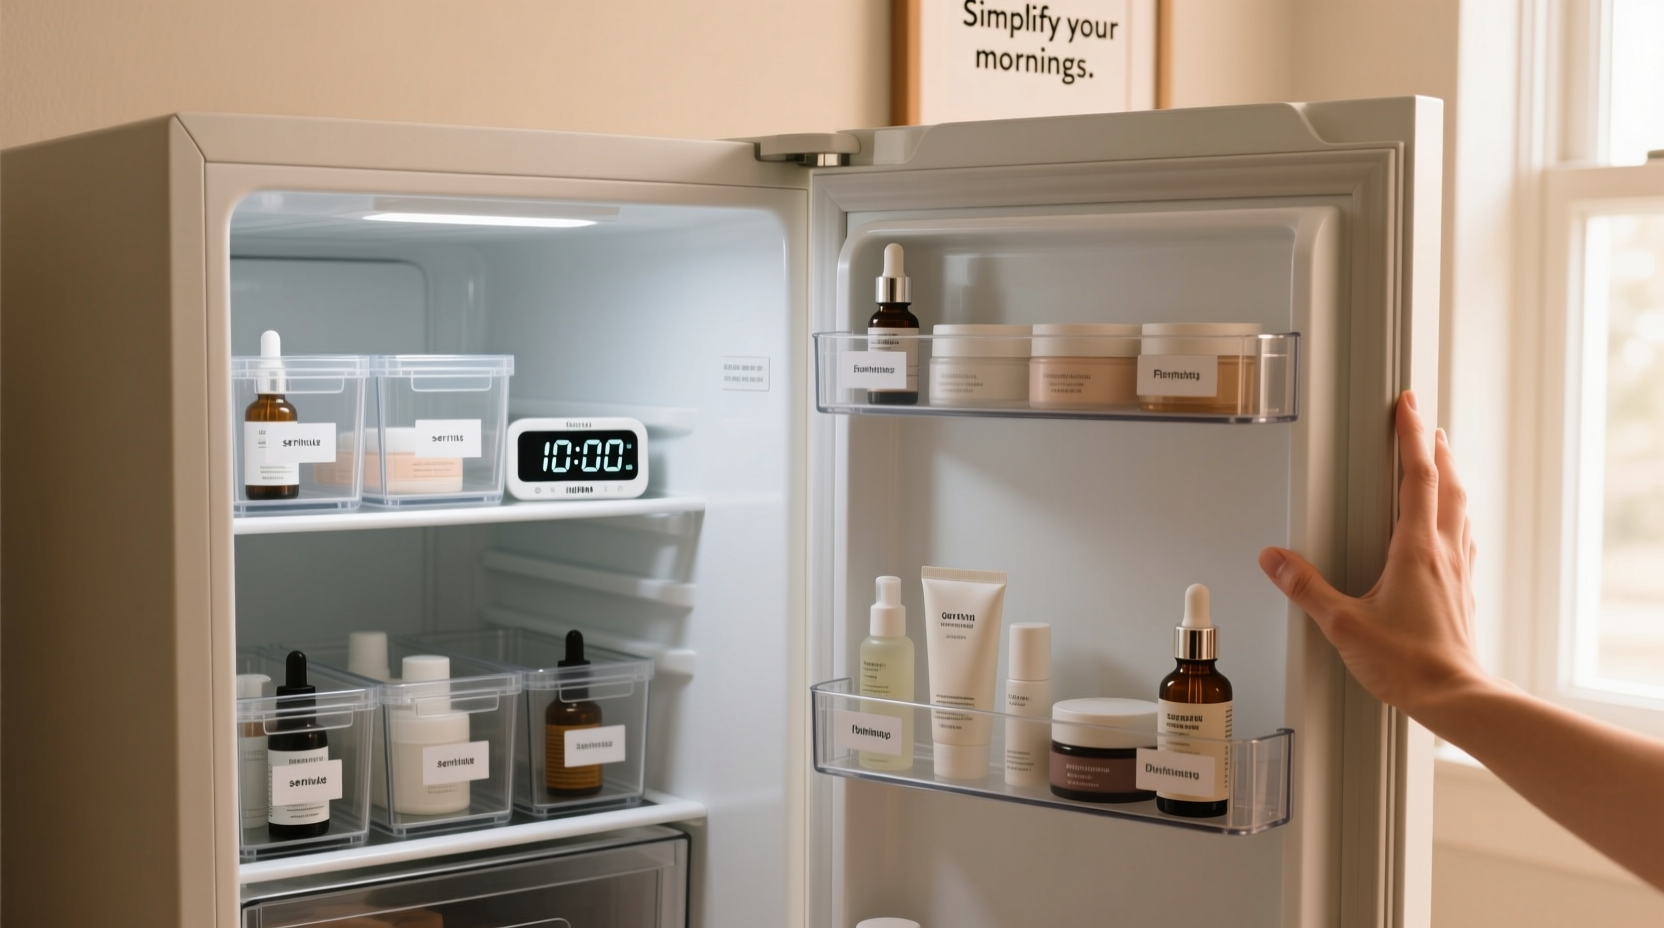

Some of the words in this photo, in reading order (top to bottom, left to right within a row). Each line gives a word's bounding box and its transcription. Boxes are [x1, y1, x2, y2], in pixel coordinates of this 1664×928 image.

[963, 0, 1061, 42] Simplify
[1067, 16, 1119, 43] your
[976, 47, 1094, 85] mornings.
[542, 439, 624, 473] 10:00
